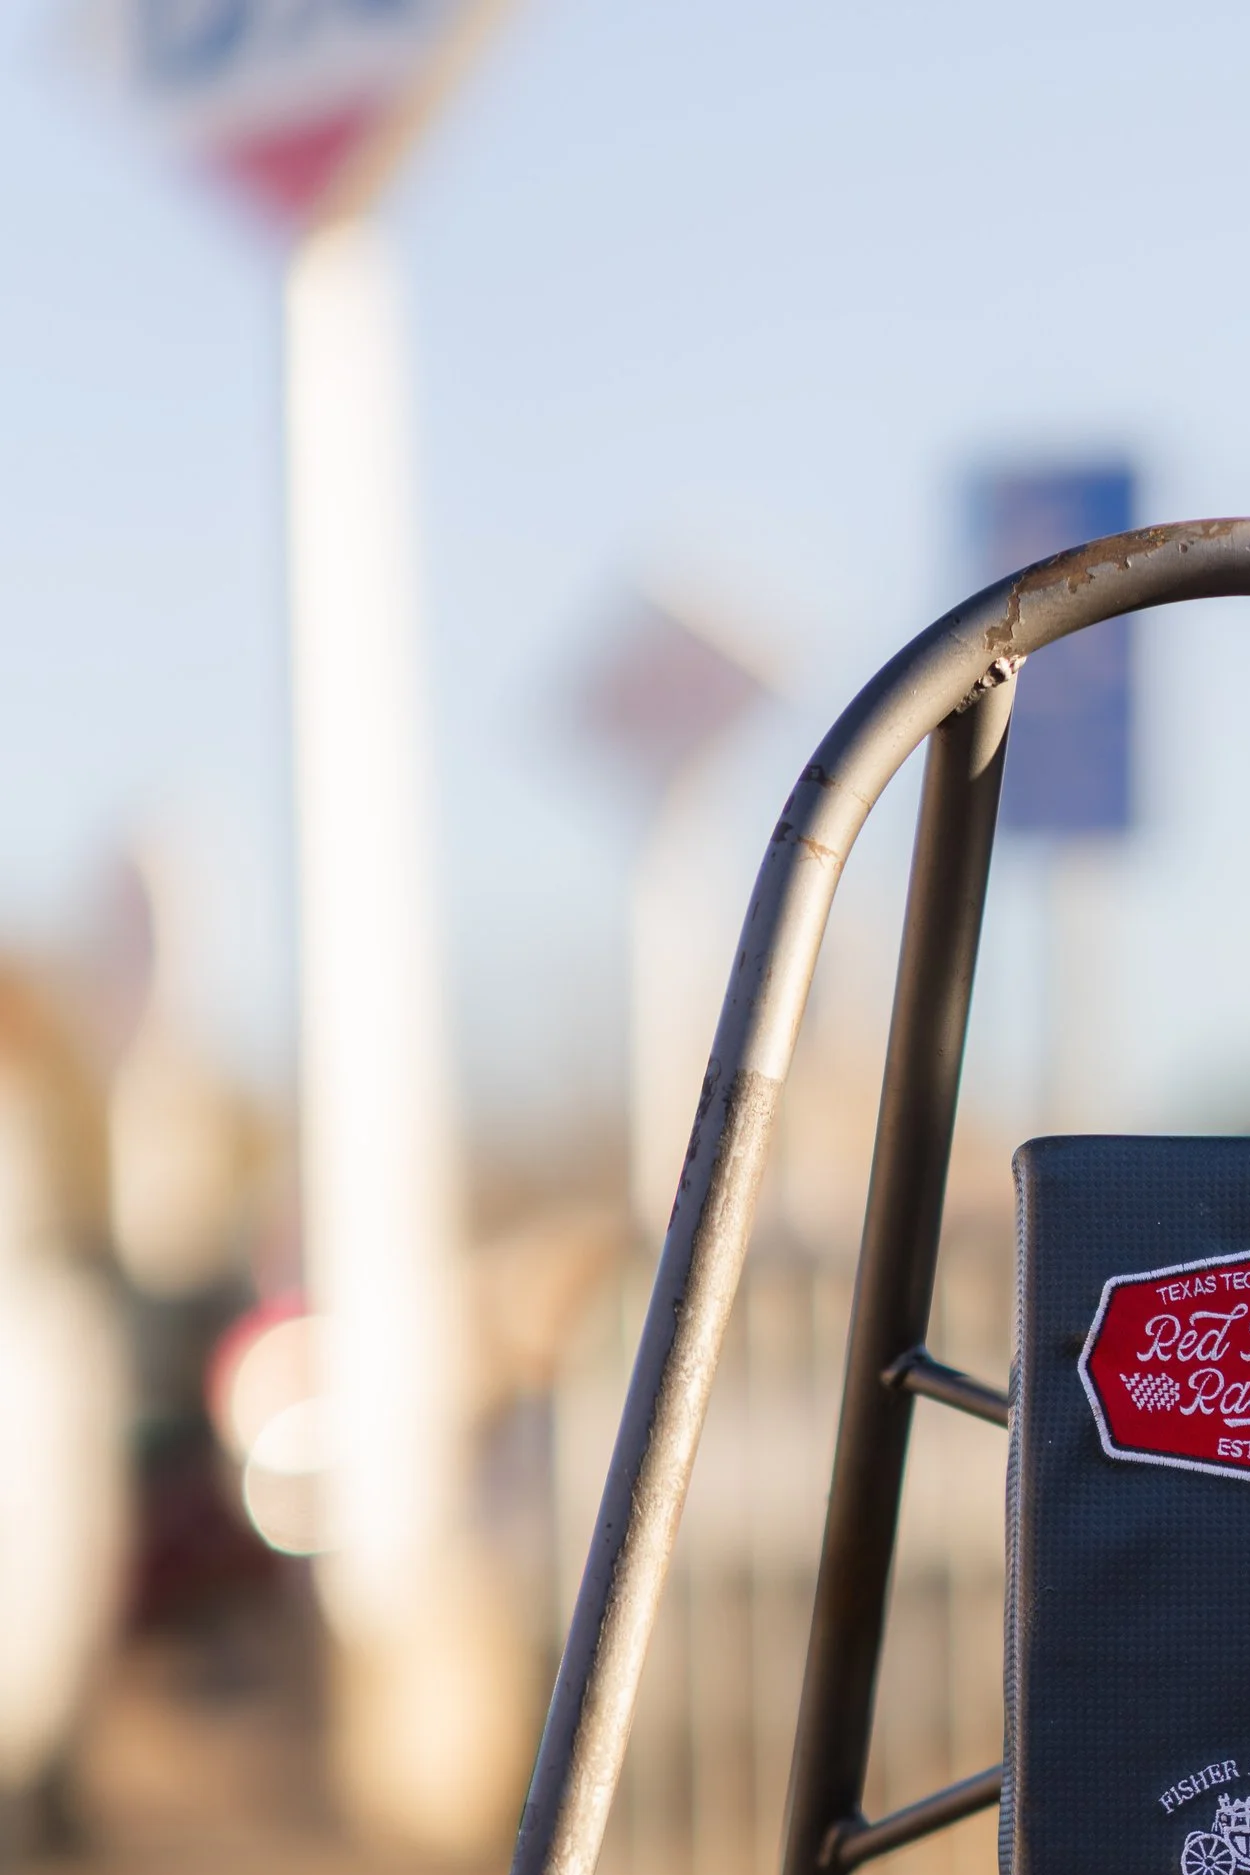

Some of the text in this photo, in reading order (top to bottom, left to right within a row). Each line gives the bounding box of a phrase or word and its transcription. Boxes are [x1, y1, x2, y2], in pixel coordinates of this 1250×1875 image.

[1156, 1273, 1216, 1305] TEXAS
[1136, 1303, 1249, 1362] Red
[1158, 1759, 1240, 1814] FISHER
